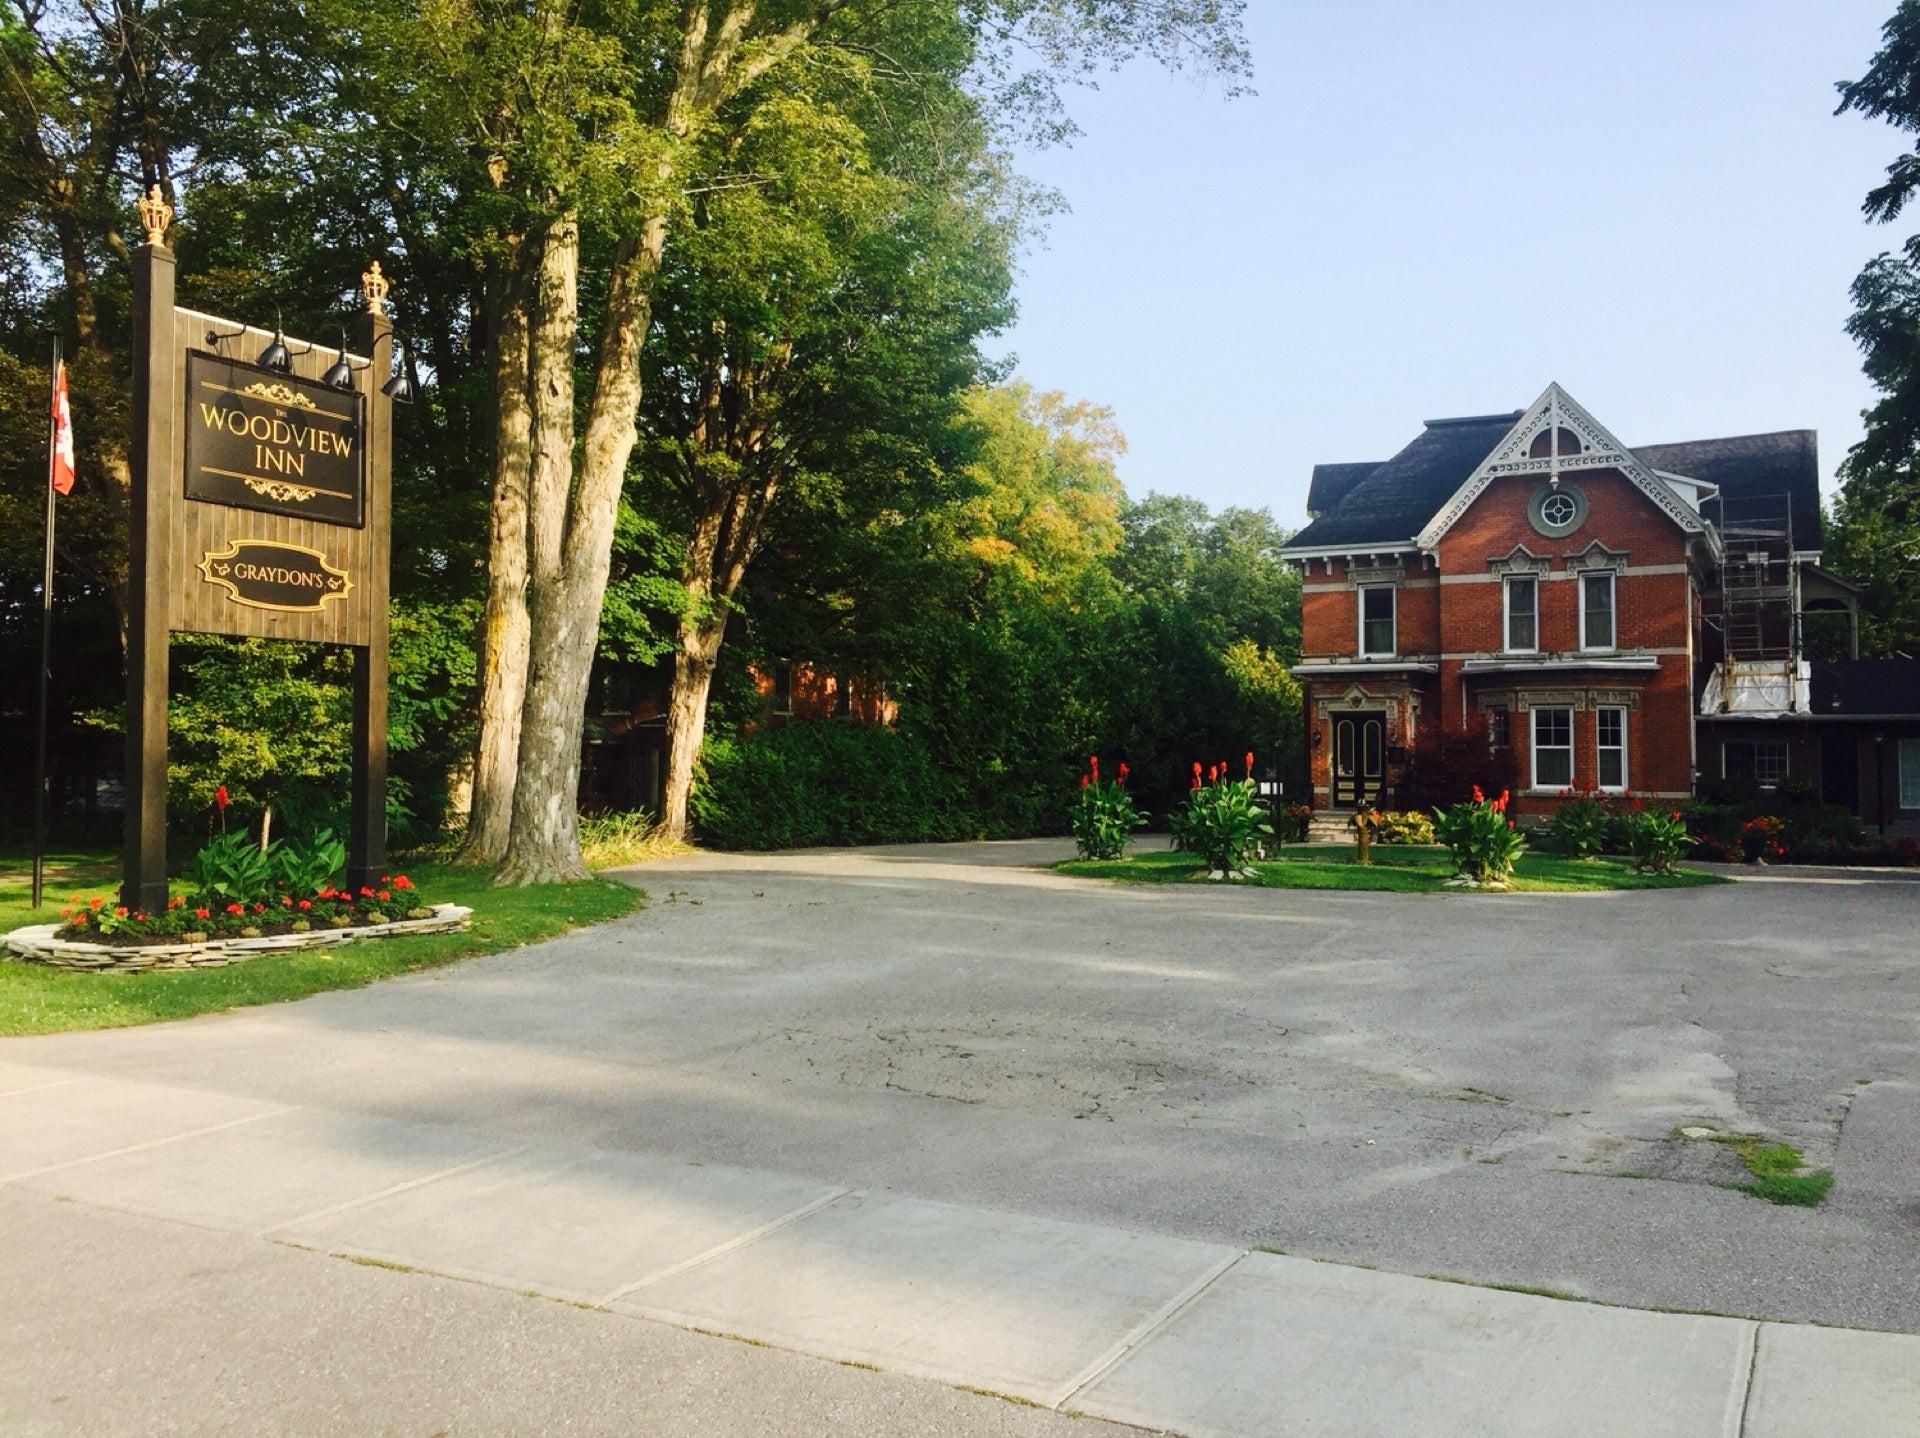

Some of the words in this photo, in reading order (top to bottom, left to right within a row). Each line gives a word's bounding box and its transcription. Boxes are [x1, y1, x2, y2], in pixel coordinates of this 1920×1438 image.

[200, 402, 353, 459] WOODVIEW
[255, 444, 306, 477] INN
[234, 562, 323, 588] GRAYDON'S
